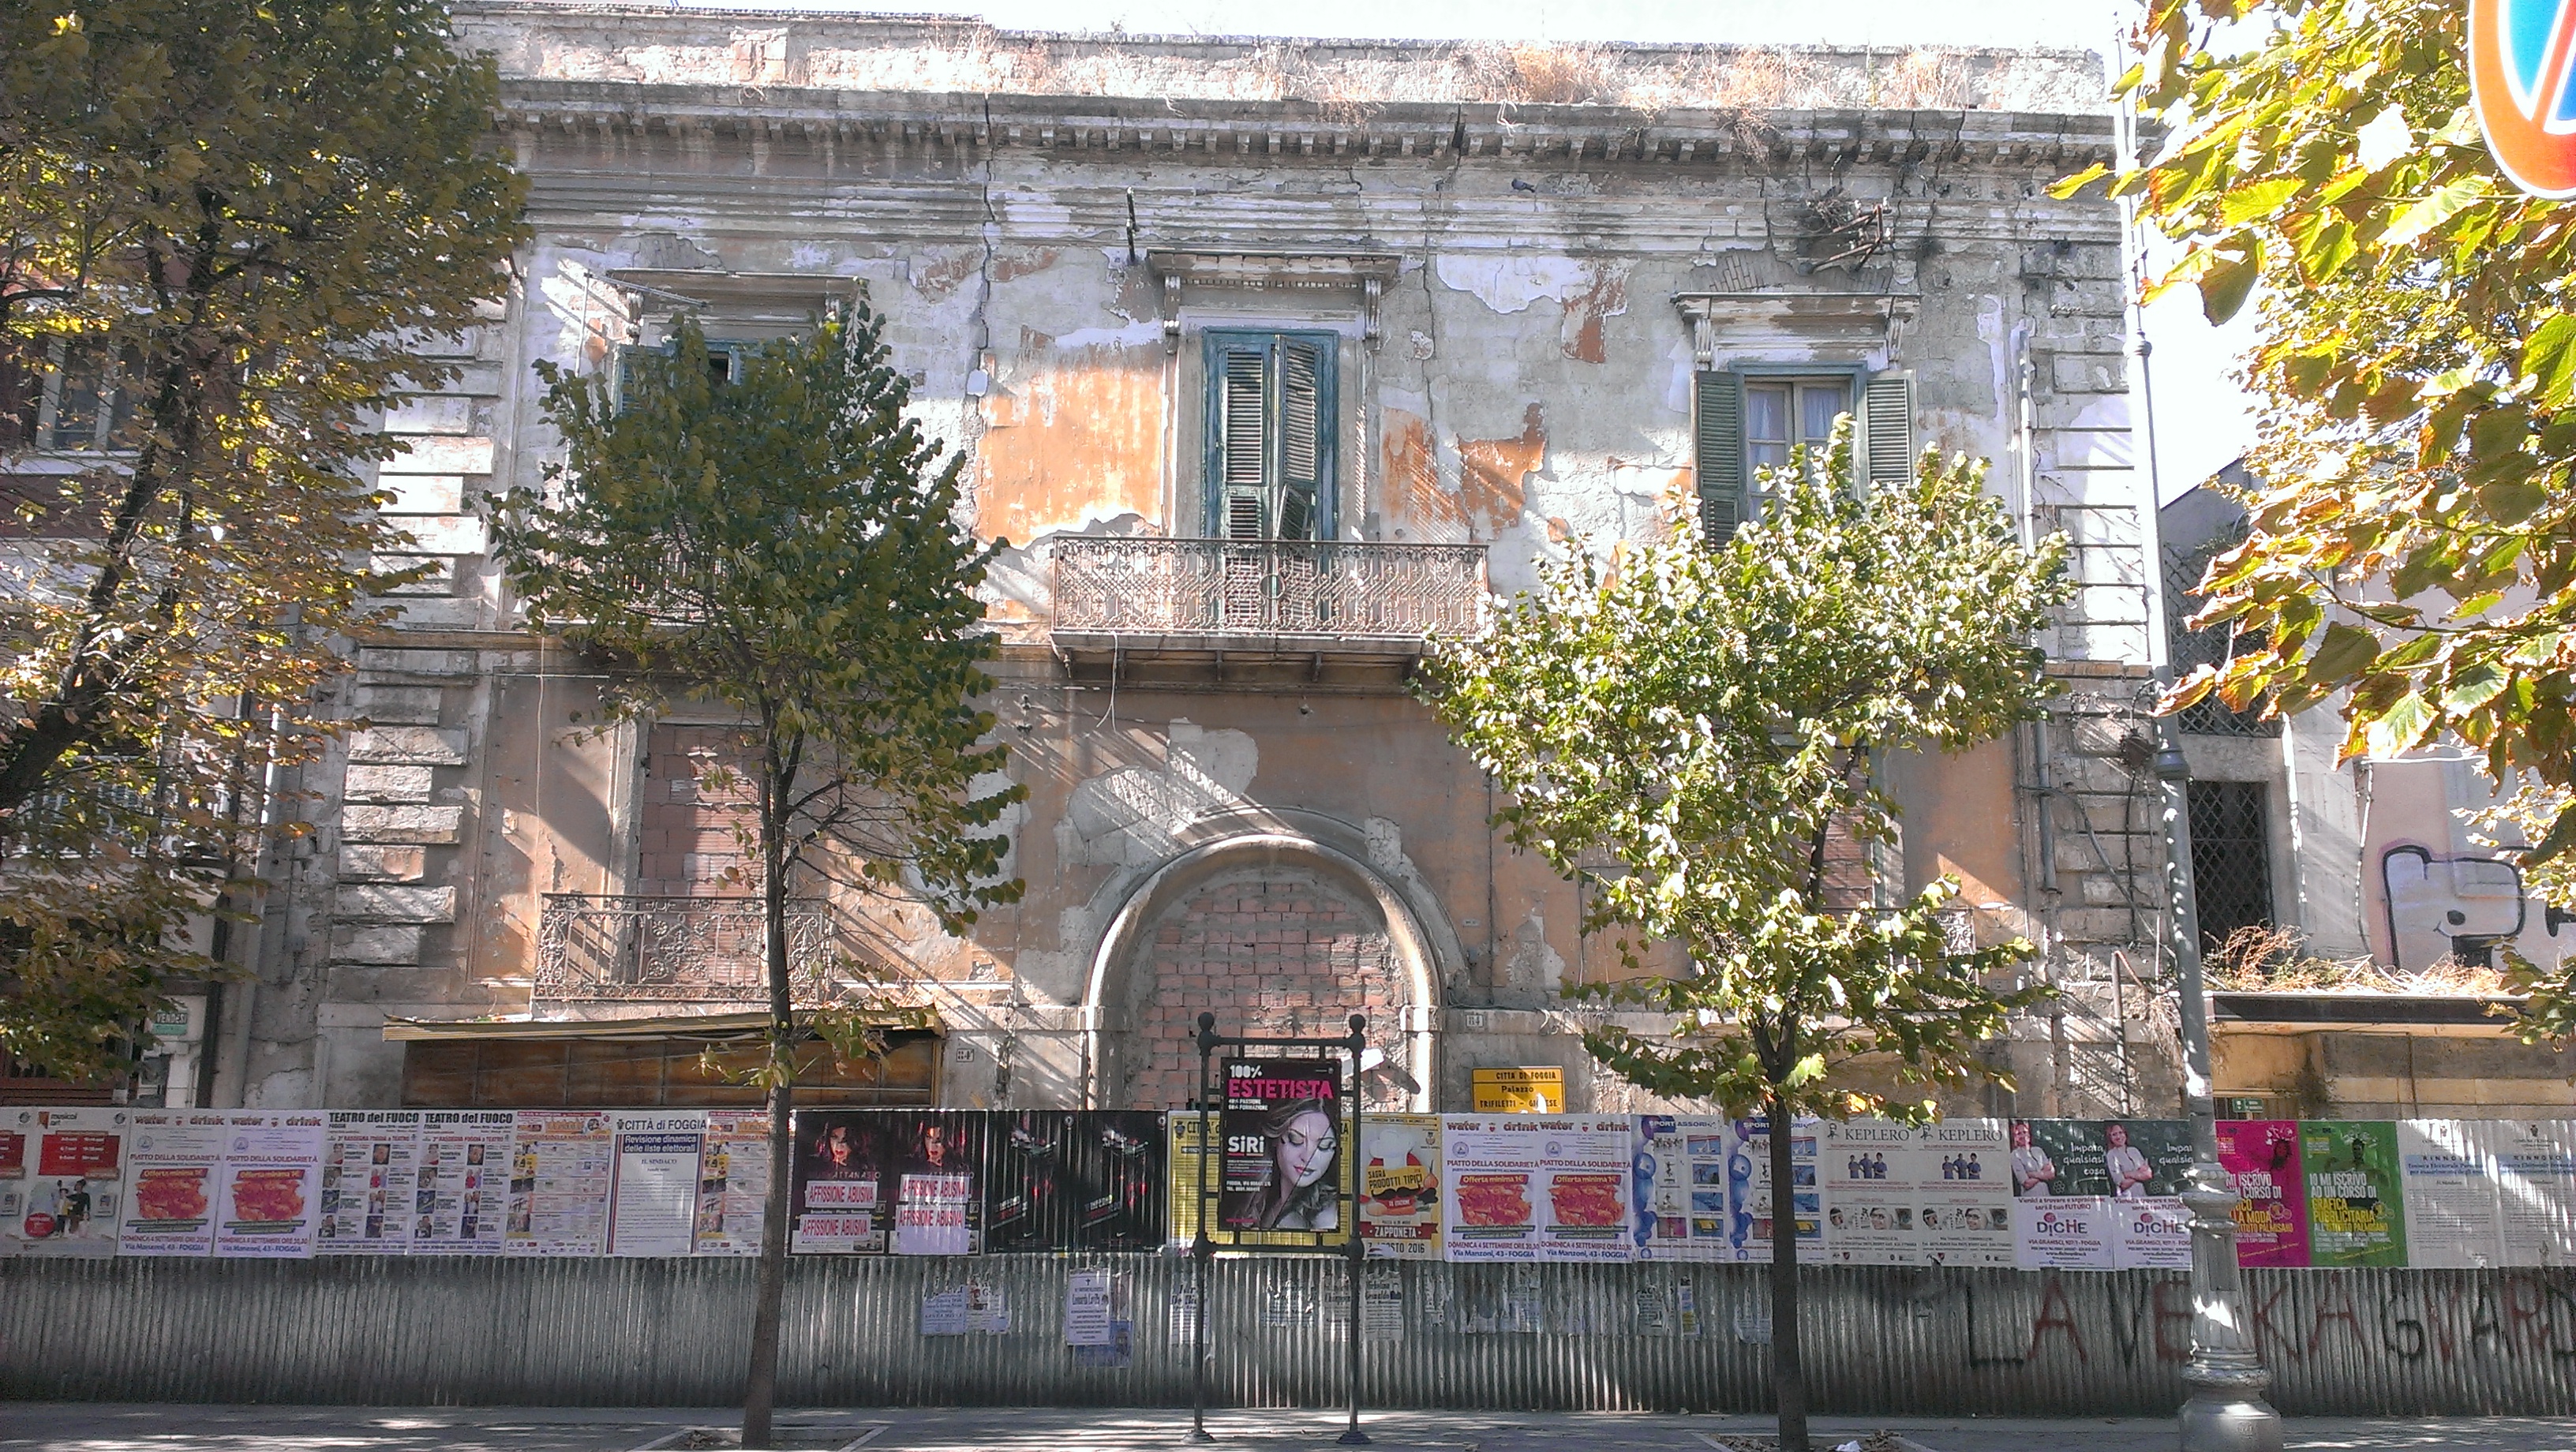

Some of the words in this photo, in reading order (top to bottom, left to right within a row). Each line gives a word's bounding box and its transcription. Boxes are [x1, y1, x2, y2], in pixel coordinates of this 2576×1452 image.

[1230, 1065, 1263, 1079] 100%
[1228, 1079, 1334, 1099] ESTETISTA
[189, 1115, 225, 1125] drink
[328, 1112, 365, 1123] TEATRO
[366, 1112, 384, 1123] del
[385, 1113, 419, 1123] FUOCO
[425, 1113, 459, 1123] TEATRO
[461, 1113, 477, 1124] del
[478, 1113, 513, 1124] FUOCO
[624, 1117, 653, 1130] CITTÀ
[657, 1119, 665, 1130] di
[668, 1119, 707, 1130] FOGGIA
[1447, 1121, 1481, 1132] water
[1503, 1121, 1538, 1132] drink
[1539, 1120, 1574, 1131] water
[1596, 1121, 1630, 1132] drink
[624, 1135, 661, 1143] Revisione
[1845, 1128, 1910, 1141] KEPLERO
[1938, 1129, 2003, 1142] KEPLERO
[2070, 1142, 2104, 1154] Impara
[1494, 1159, 1539, 1168] SOLIDARIETÀ
[1587, 1159, 1631, 1169] SOLIDARIETÀ
[2063, 1154, 2105, 1166] qualsiasi
[1368, 1169, 1386, 1179] SAGRA
[2238, 1173, 2272, 1187] ISCRIVO
[2309, 1173, 2318, 1186] IO
[2320, 1173, 2332, 1186] MI
[2333, 1173, 2367, 1186] ISCRIVO
[1368, 1176, 1401, 1189] PRODOTTI
[1404, 1173, 1423, 1184] TIPICI
[808, 1186, 845, 1202] AFFISSIONE
[847, 1187, 874, 1203] ABUSIVA
[903, 1181, 938, 1196] AFFISSIONE
[940, 1181, 965, 1197] ABUSIVA
[2243, 1186, 2270, 1199] CORSO
[2271, 1186, 2282, 1199] DI
[2311, 1185, 2324, 1199] AD
[2326, 1185, 2337, 1199] UN
[2338, 1185, 2366, 1199] CORSO
[2367, 1185, 2377, 1199] DI
[2311, 1198, 2348, 1211] GRAFICA
[898, 1210, 934, 1226] AFFISSIONE
[936, 1210, 962, 1226] ABUSIVA
[2248, 1210, 2272, 1223] MODA
[2313, 1210, 2375, 1223] PUBBLICITARIA
[802, 1220, 839, 1236] AFFISSIONE
[841, 1220, 867, 1236] ABUSIVA
[1374, 1227, 1417, 1238] ZAPPONETA
[1408, 1243, 1425, 1253] 2016
